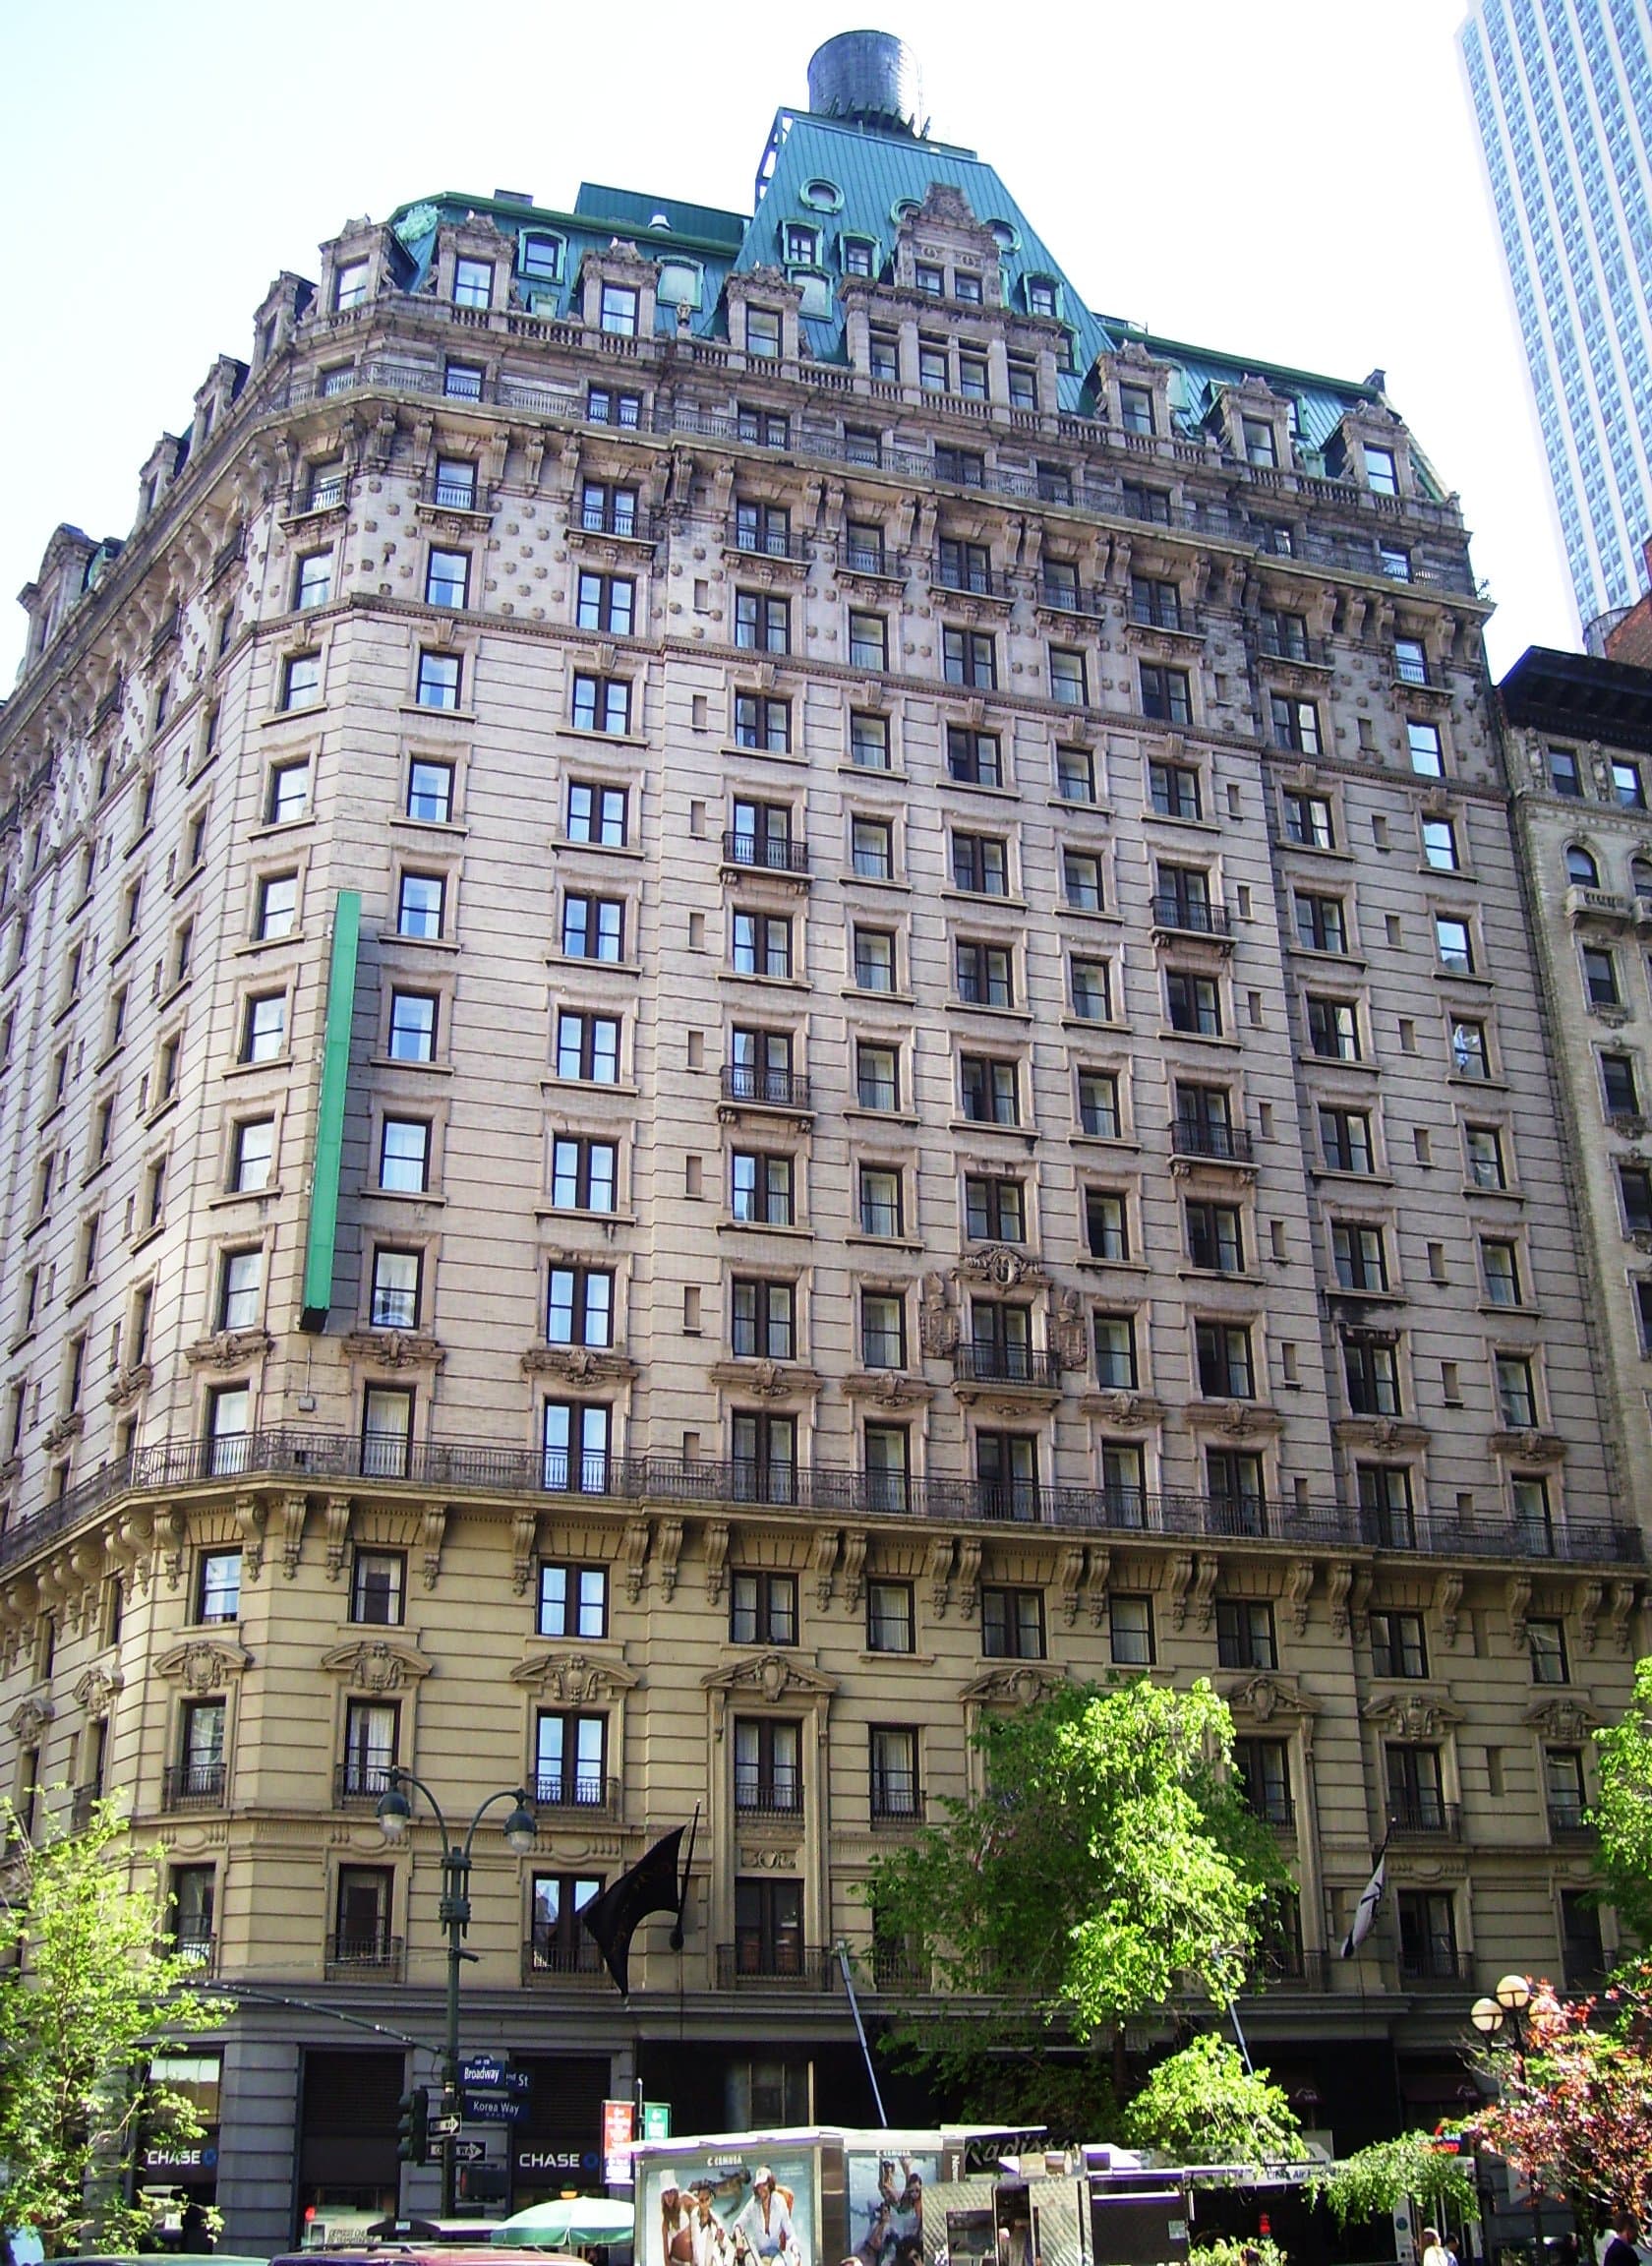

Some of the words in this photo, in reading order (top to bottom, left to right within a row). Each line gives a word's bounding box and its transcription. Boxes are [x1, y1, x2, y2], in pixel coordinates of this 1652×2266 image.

[463, 2066, 500, 2084] Broadway
[517, 2073, 529, 2087] St
[473, 2101, 499, 2113] Korea
[501, 2101, 520, 2117] Way
[148, 2149, 201, 2166] CHASE
[519, 2153, 580, 2168] CHASE
